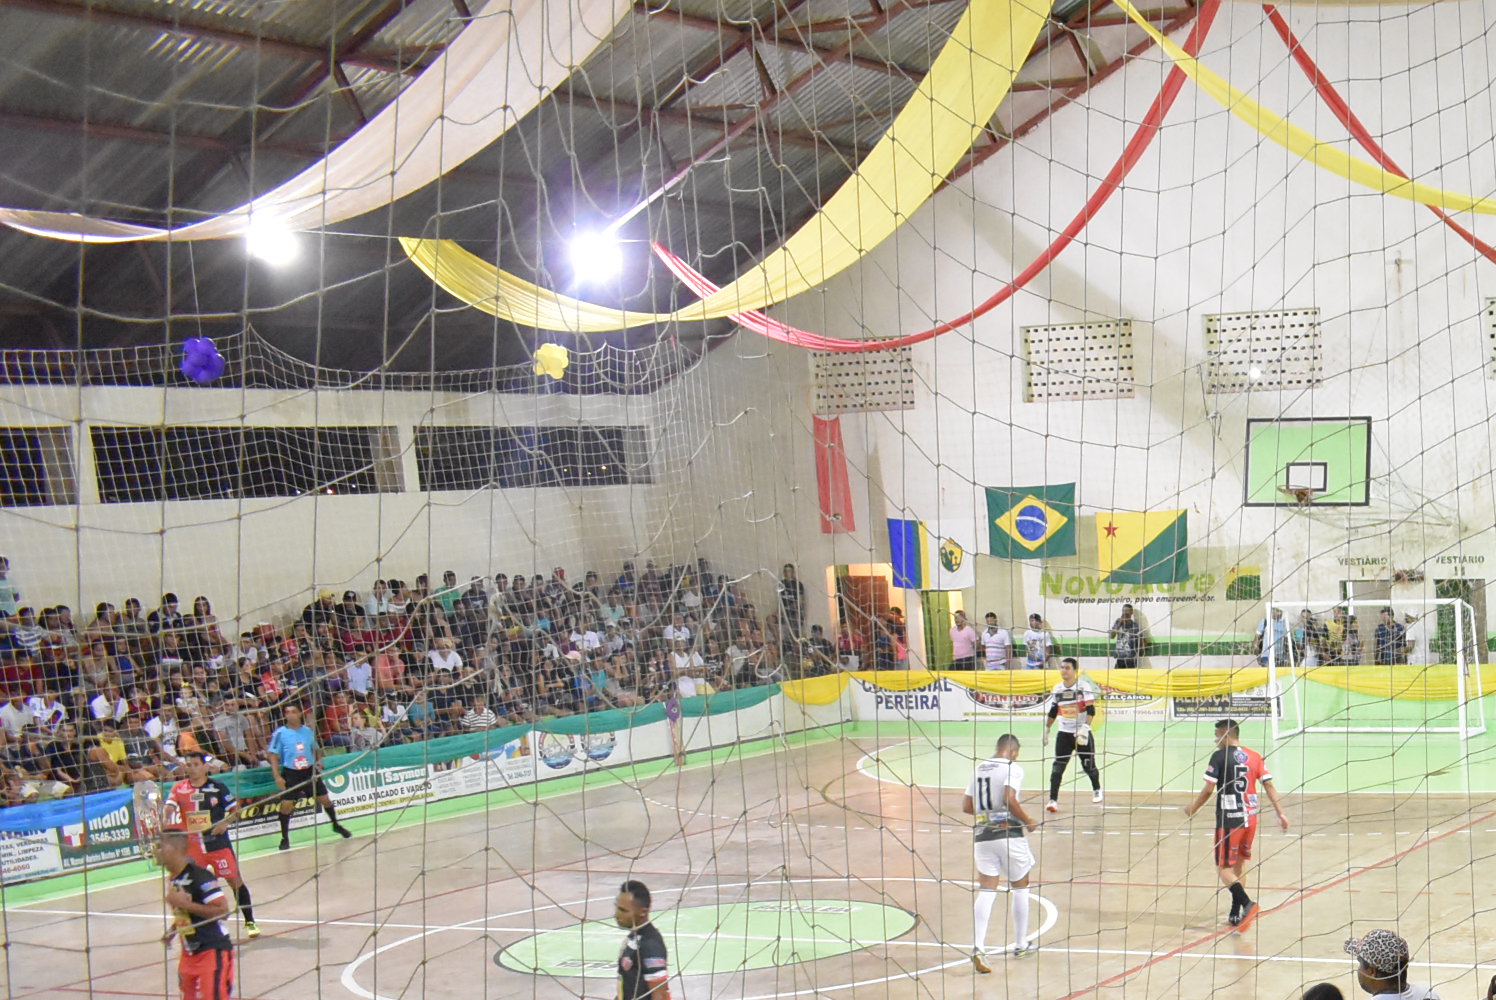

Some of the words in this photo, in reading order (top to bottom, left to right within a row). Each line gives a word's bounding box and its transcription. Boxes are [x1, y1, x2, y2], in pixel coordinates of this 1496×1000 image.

[1338, 555, 1388, 566] VESTIÁRIO
[1063, 595, 1096, 605] Governo
[1135, 595, 1154, 604] povo
[876, 694, 940, 710] PEREIRA
[1234, 764, 1250, 794] 5
[332, 796, 356, 808] ENDAS
[356, 794, 367, 803] NO
[368, 787, 399, 801] ATACADO
[977, 776, 993, 811] 11
[90, 827, 130, 844] 3546-3339
[18, 845, 44, 856] LIMPEZA
